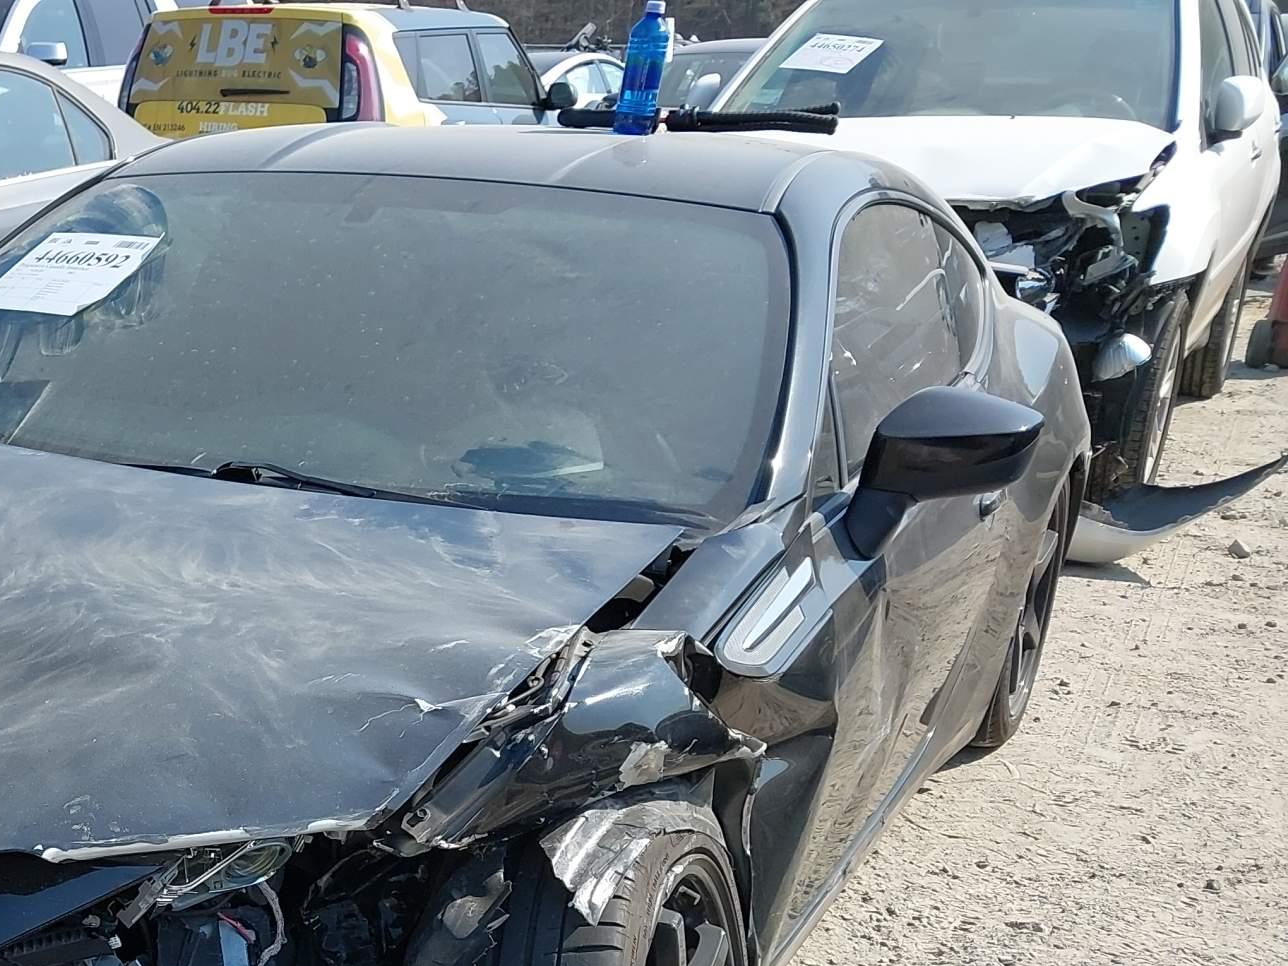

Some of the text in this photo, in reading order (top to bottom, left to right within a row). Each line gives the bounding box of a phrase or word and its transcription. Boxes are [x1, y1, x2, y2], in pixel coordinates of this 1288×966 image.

[195, 20, 272, 67] LBE
[176, 69, 218, 78] LIGHTNING
[241, 70, 282, 79] ELECTRIC
[35, 249, 131, 268] 44660592
